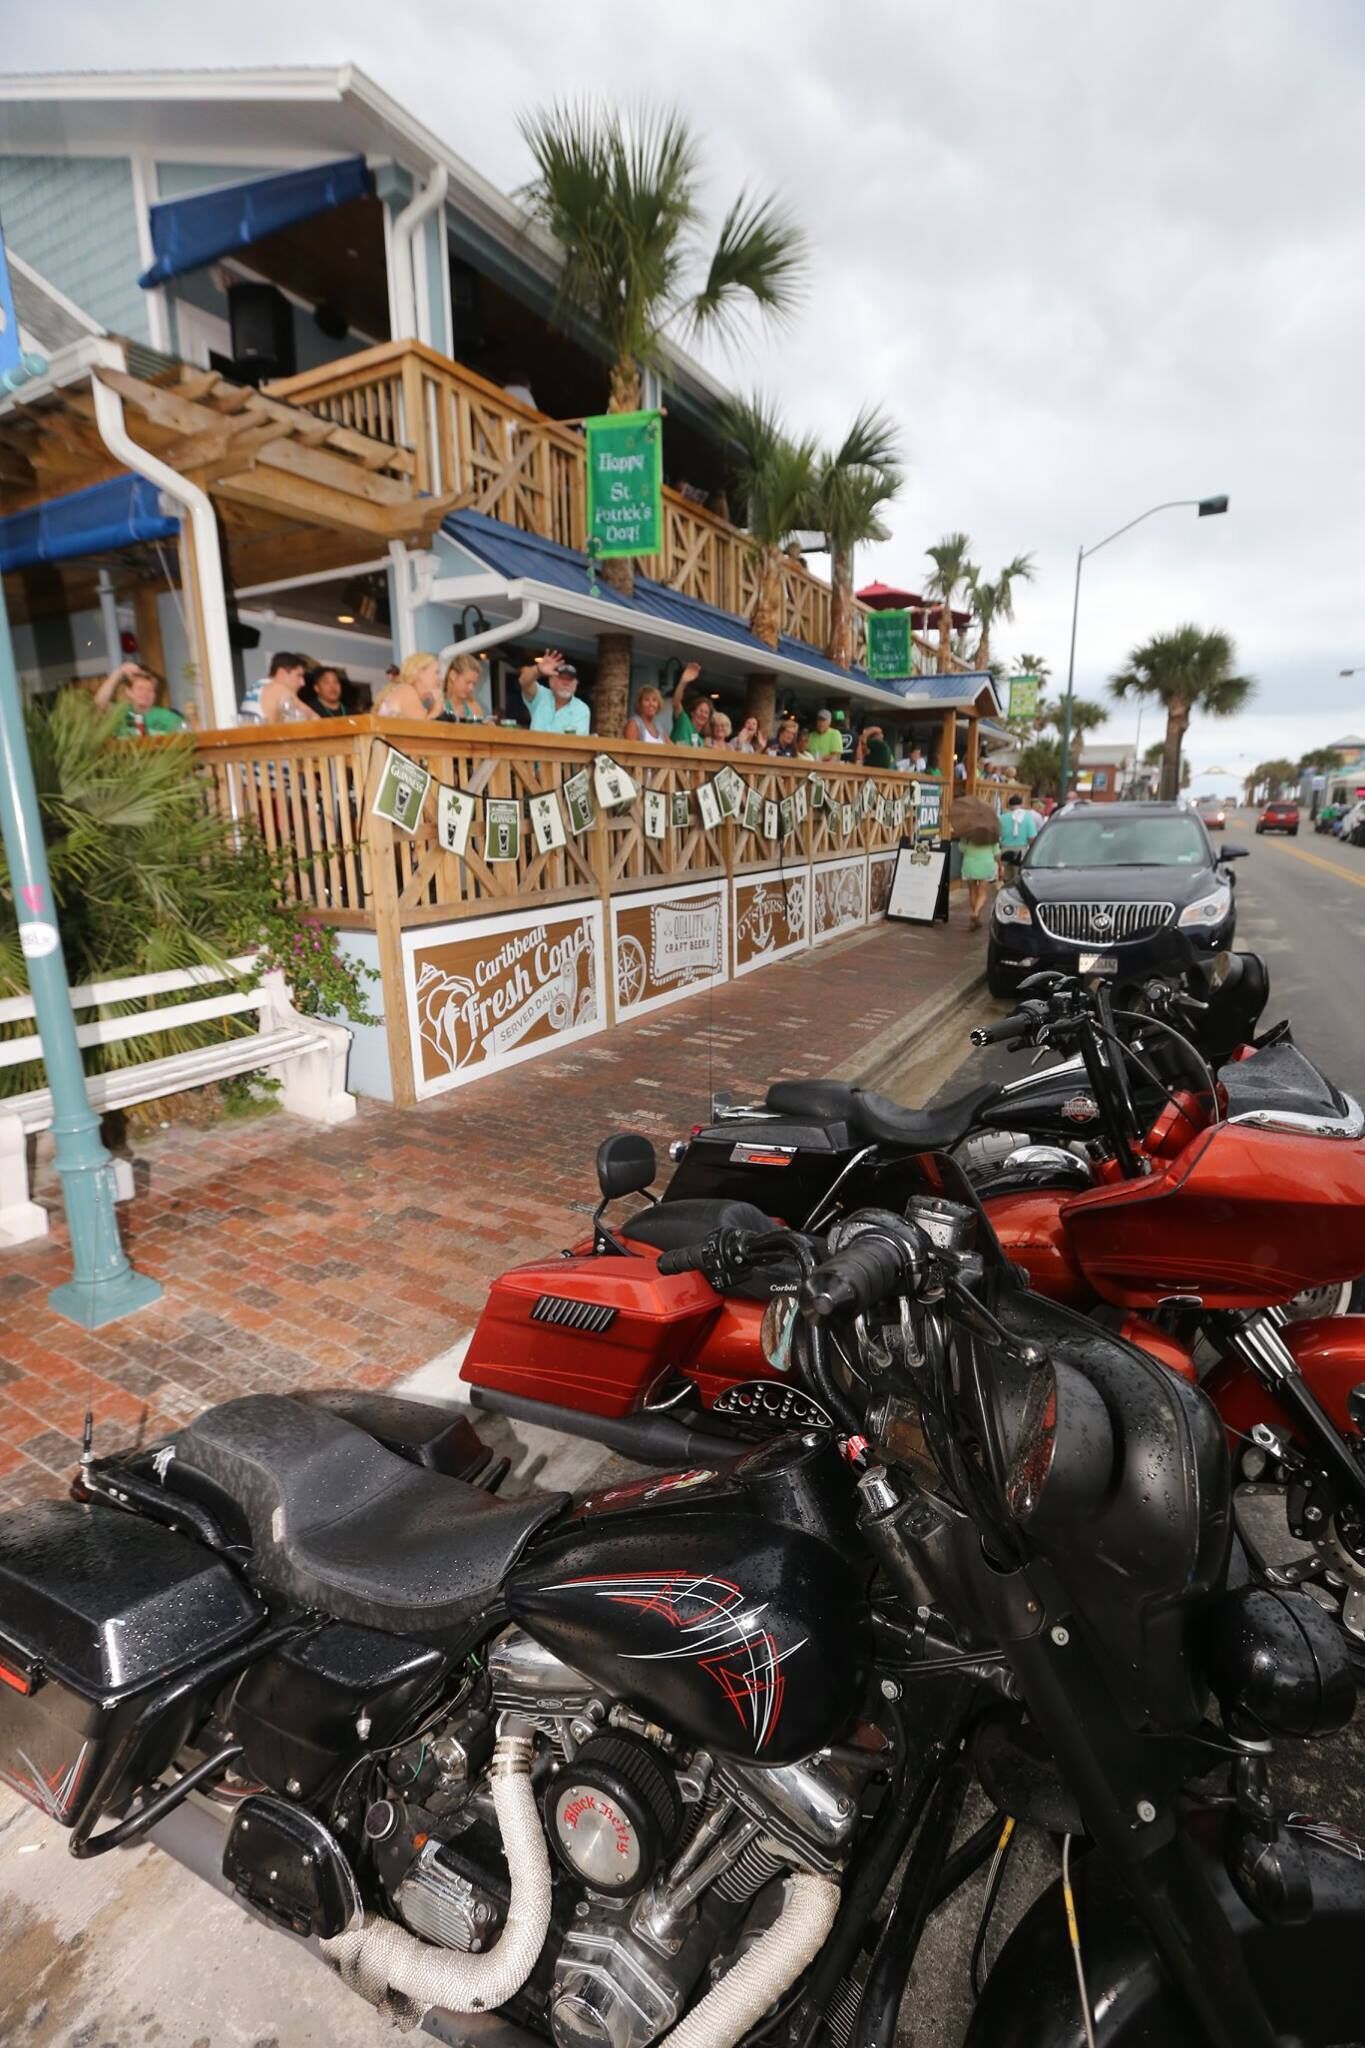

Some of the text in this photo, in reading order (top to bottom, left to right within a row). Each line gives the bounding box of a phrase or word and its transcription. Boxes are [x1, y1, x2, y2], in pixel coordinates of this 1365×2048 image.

[598, 453, 645, 473] Happy
[665, 938, 710, 954] CRAFT BEERS
[674, 913, 705, 940] QUALITY
[475, 924, 548, 988] Caribbean
[461, 962, 533, 1040] Fresh
[499, 986, 562, 1042] SERVED DAILY
[769, 1283, 798, 1292] Corbin
[563, 1795, 630, 1855] Black Betty
